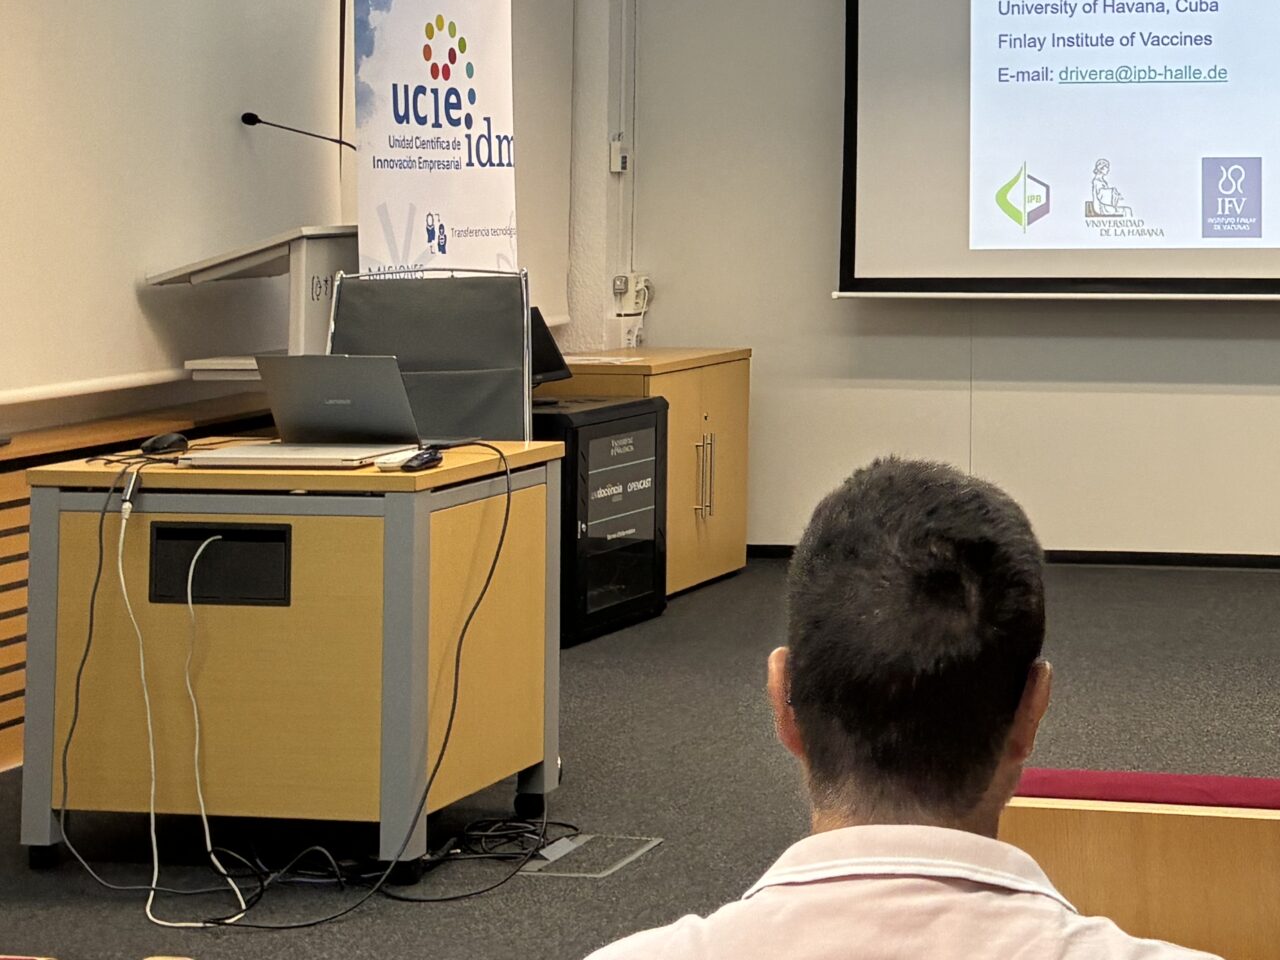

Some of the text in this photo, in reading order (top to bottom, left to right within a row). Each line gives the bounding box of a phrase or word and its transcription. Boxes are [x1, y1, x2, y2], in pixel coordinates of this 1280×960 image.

[998, 0, 1077, 18] University
[998, 31, 1213, 51] Finlay Institute of Vaccines
[998, 64, 1229, 85] E-mail: drivera@ipb-halle.de
[388, 135, 414, 149] Unidad
[451, 138, 461, 151] de
[372, 155, 462, 172] Innovación Empresarial
[1217, 197, 1247, 215] IFV
[451, 227, 490, 238] Transferencia
[1100, 228, 1165, 237] DE LA HABANA
